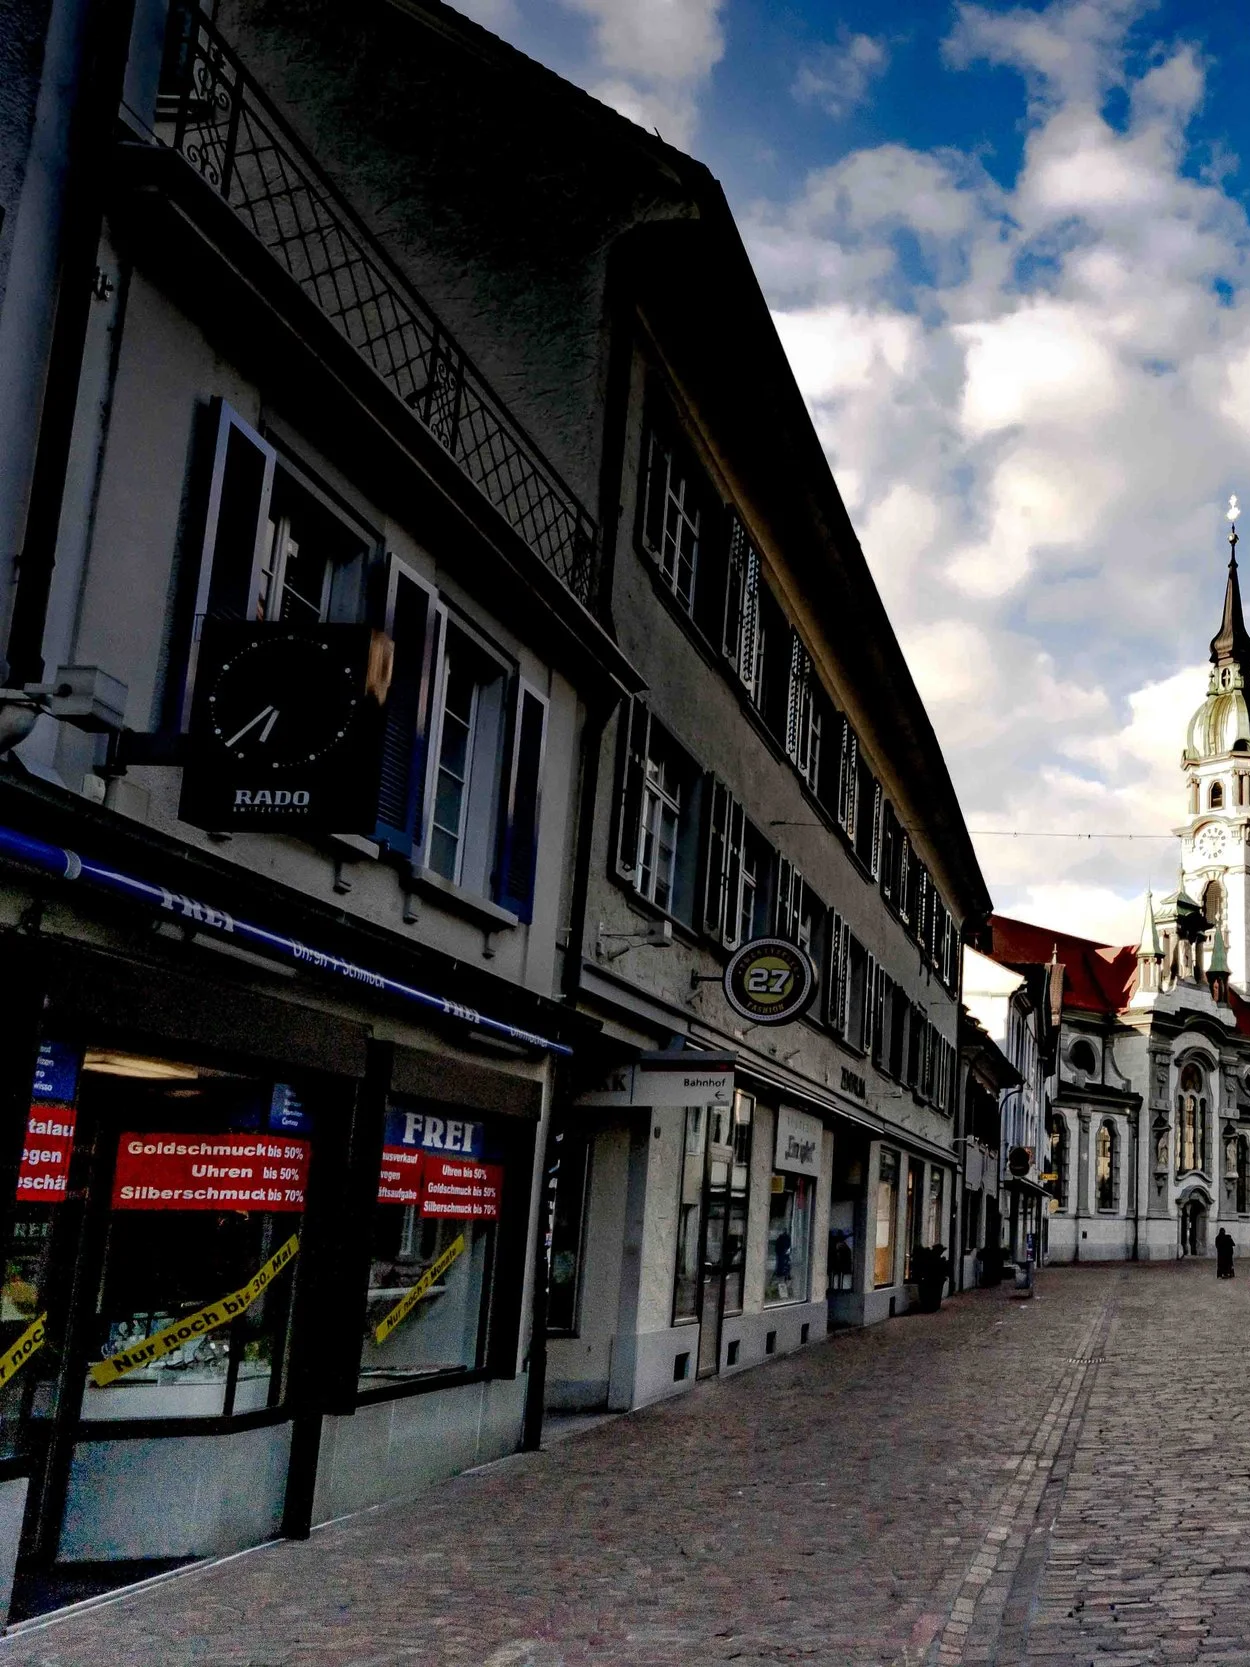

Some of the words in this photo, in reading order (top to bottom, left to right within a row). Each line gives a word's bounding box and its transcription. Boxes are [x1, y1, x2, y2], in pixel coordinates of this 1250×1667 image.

[234, 789, 311, 805] RADO
[159, 886, 235, 933] FREI
[748, 967, 791, 993] 27
[745, 1001, 785, 1014] FASHION
[684, 1078, 726, 1088] Bahnhof
[402, 1112, 475, 1153] FREI
[127, 1141, 266, 1157] Goldschmuck
[267, 1144, 282, 1158] bis
[284, 1147, 304, 1160] 50%
[191, 1164, 253, 1178] Uhren
[263, 1167, 278, 1180] bis
[280, 1168, 299, 1181] 50%
[442, 1164, 462, 1177] Uhren
[463, 1168, 473, 1179] bis
[474, 1168, 487, 1180] 50%
[120, 1186, 266, 1200] Silberschmuck
[267, 1190, 282, 1202] bis
[284, 1189, 304, 1203] 70%
[428, 1182, 471, 1197] Goldschmuck
[473, 1186, 482, 1198] bis
[483, 1186, 496, 1199] 50%
[423, 1200, 472, 1214] Silberschmuck
[473, 1204, 482, 1214] bis
[484, 1204, 496, 1216] 70%
[112, 1344, 156, 1373] Nur
[162, 1312, 220, 1347] noch
[222, 1294, 251, 1315] bis
[252, 1271, 270, 1294] 30.
[271, 1244, 293, 1271] Mai
[386, 1311, 401, 1328] Nur
[403, 1286, 423, 1312] noch
